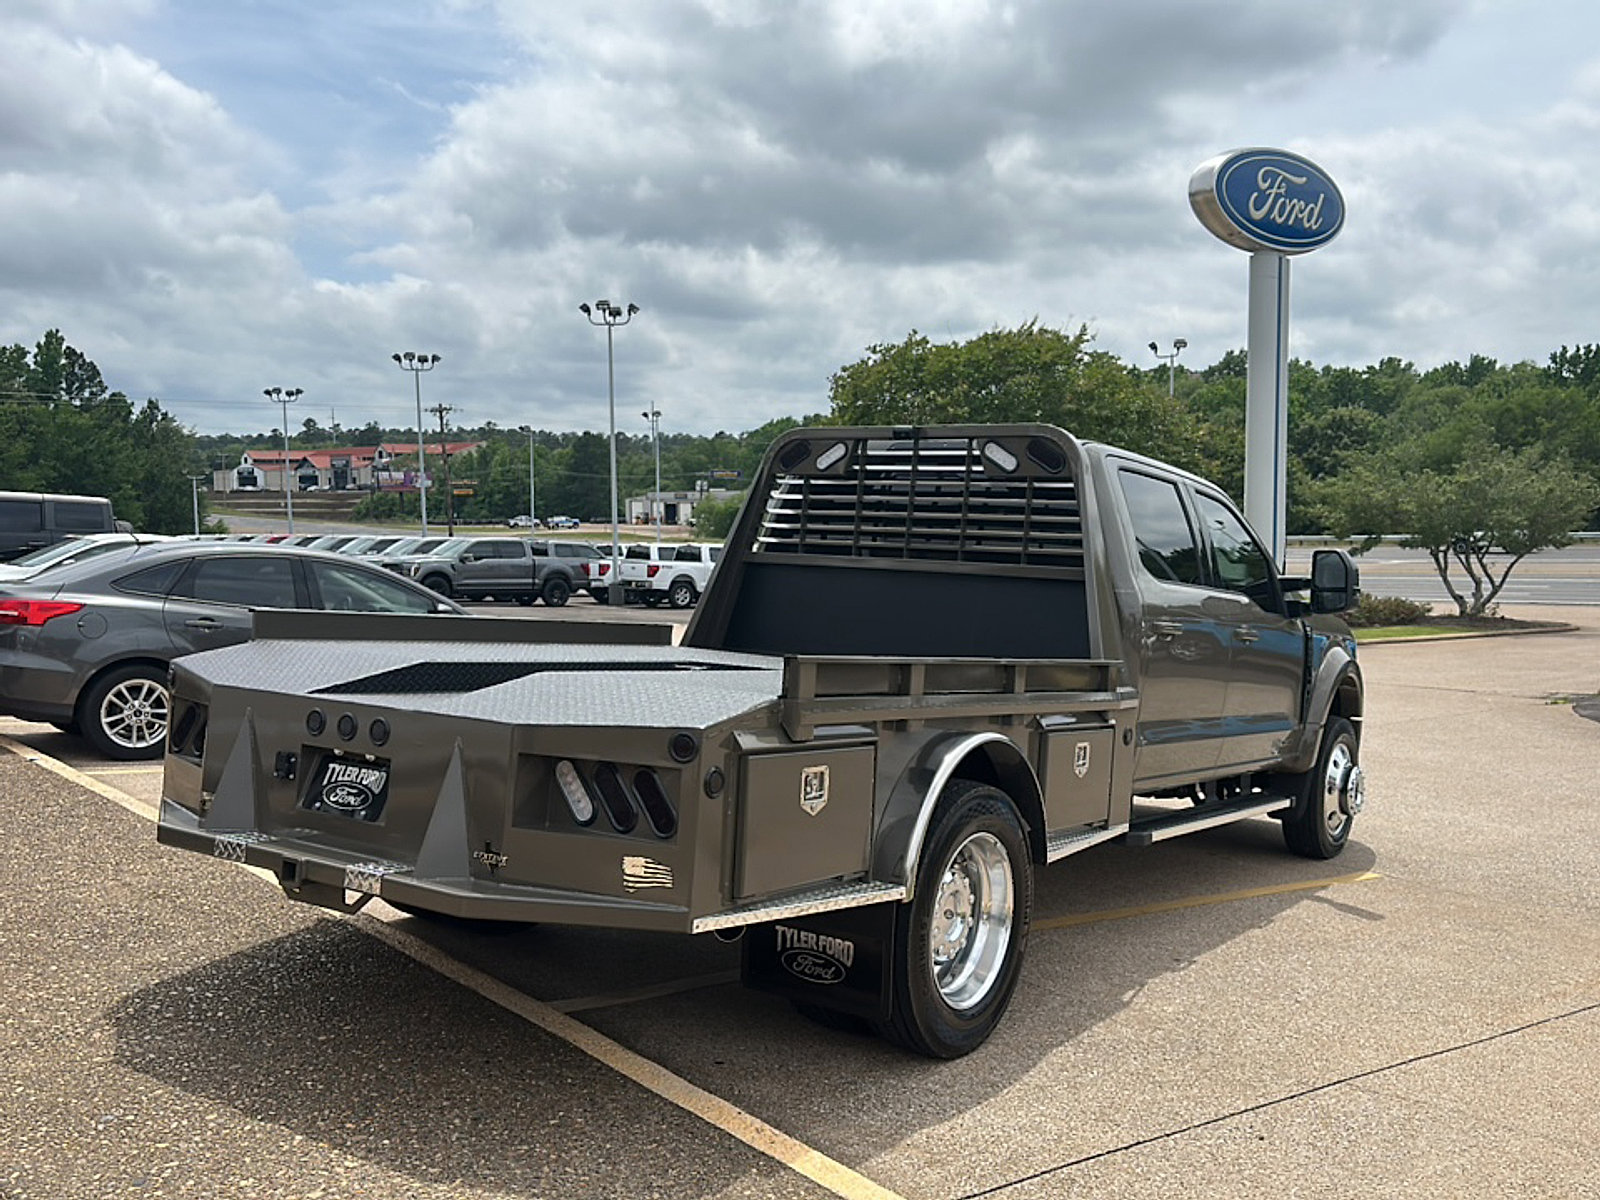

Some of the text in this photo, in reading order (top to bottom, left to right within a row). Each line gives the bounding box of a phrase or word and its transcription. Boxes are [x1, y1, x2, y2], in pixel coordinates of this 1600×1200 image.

[1249, 166, 1325, 230] Ford
[322, 763, 387, 795] TYLER FORD
[329, 786, 366, 806] Ford
[775, 925, 855, 968] TYLER FORD
[792, 953, 837, 980] Ford
